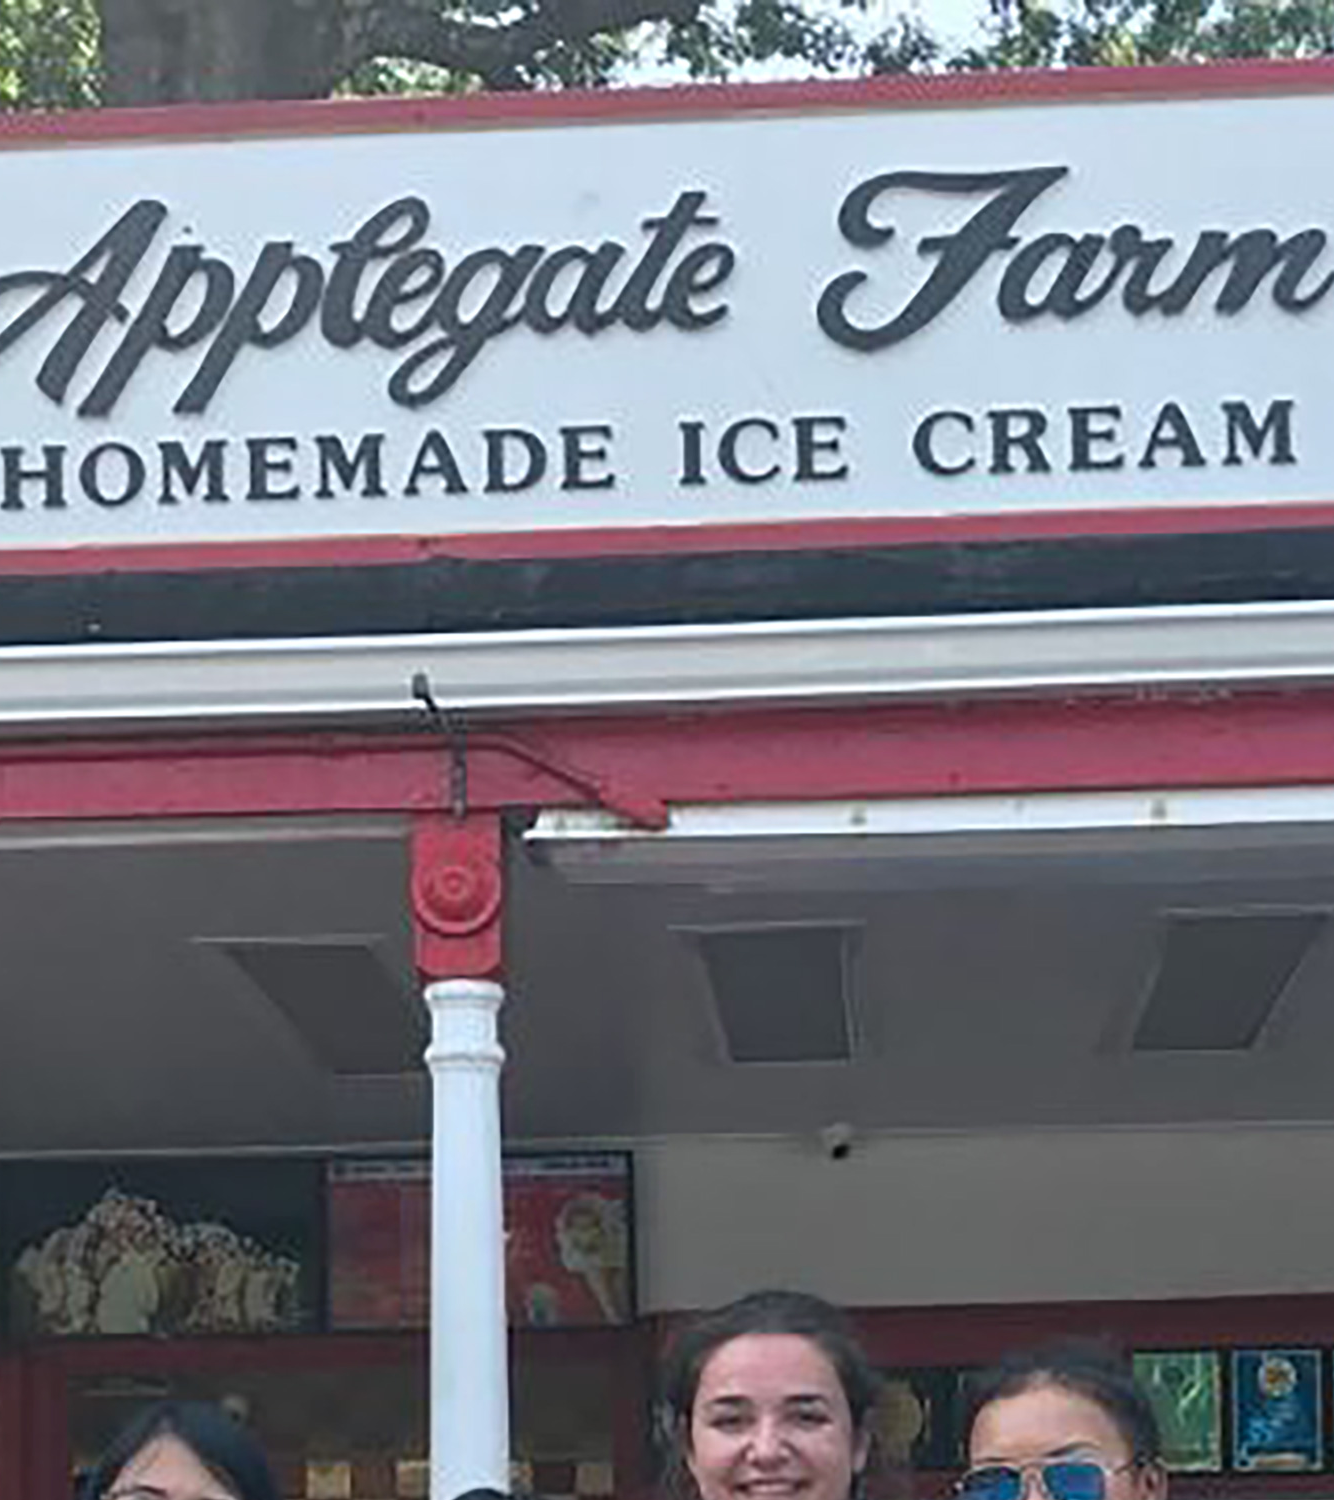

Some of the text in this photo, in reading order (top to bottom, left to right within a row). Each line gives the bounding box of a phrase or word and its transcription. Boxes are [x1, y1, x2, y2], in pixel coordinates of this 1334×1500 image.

[0, 400, 1298, 511] HOMEMADE ICE CREAM
